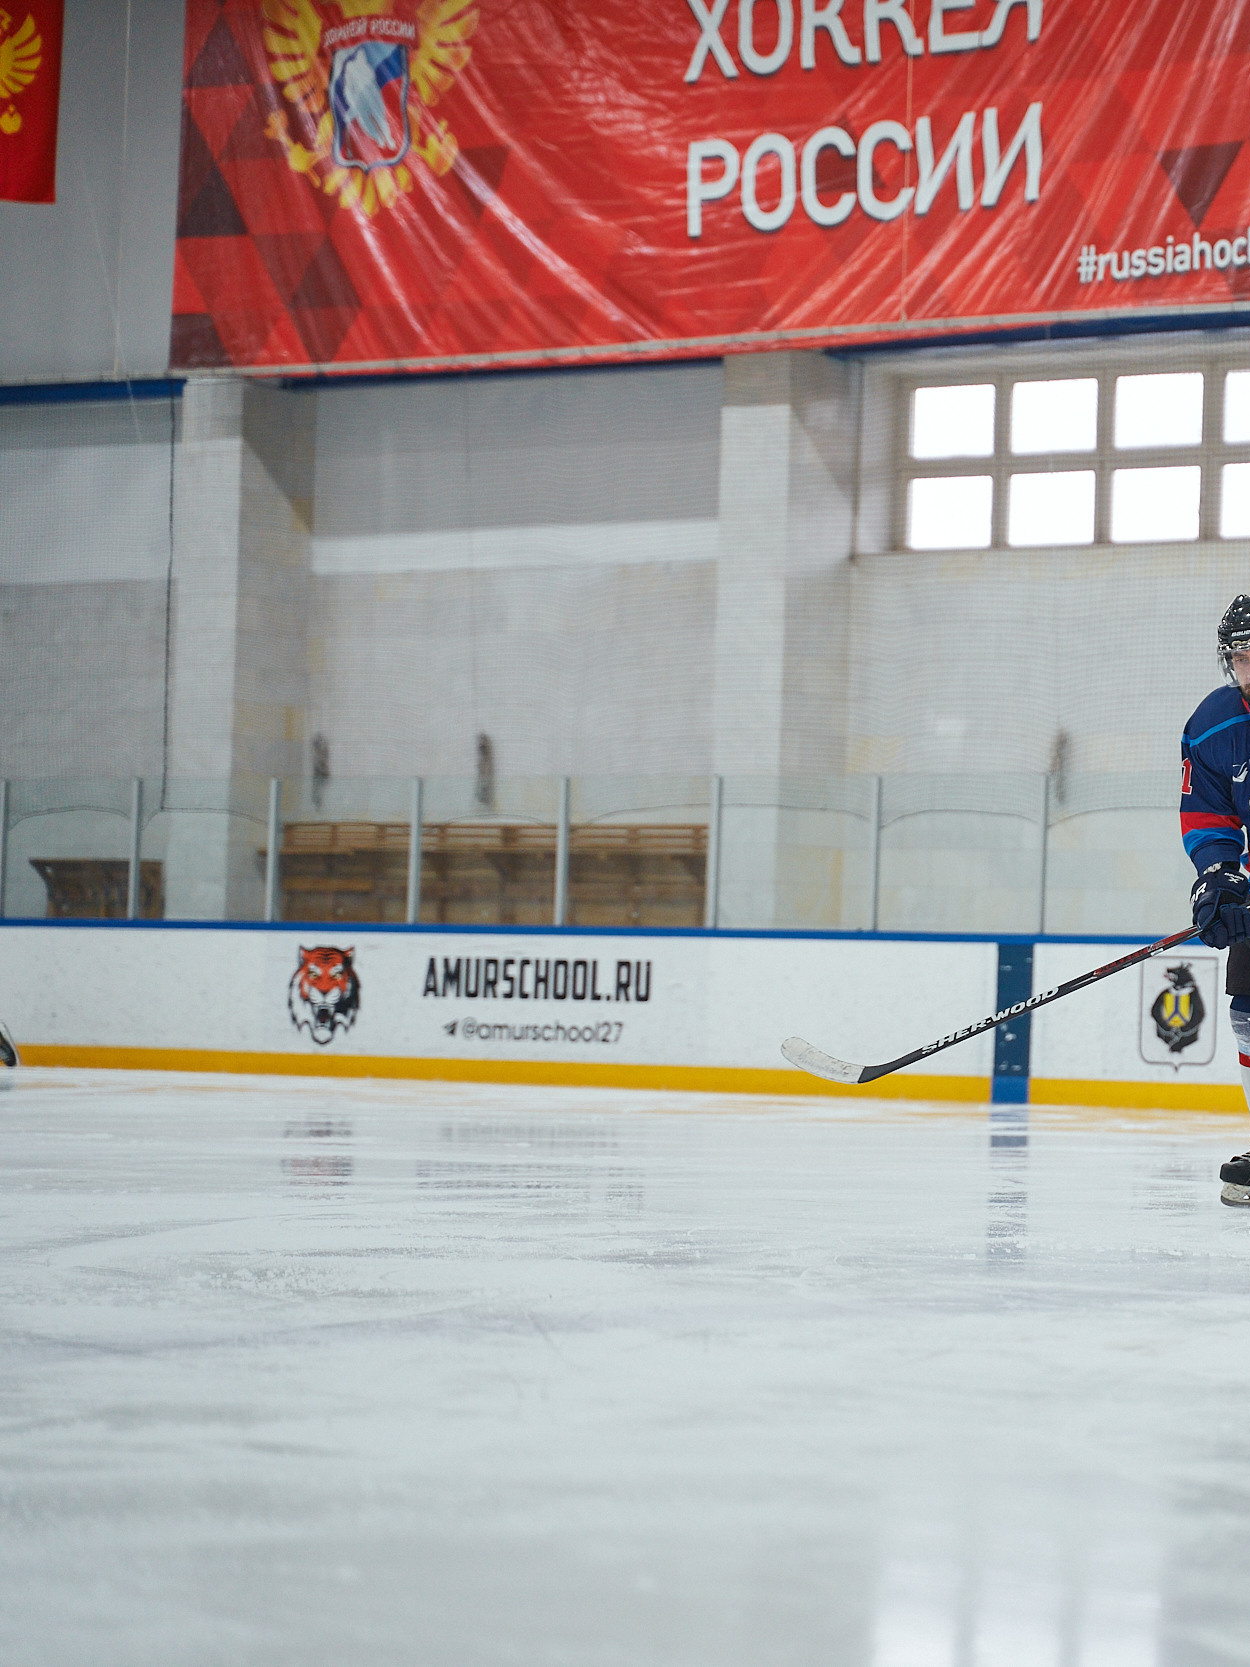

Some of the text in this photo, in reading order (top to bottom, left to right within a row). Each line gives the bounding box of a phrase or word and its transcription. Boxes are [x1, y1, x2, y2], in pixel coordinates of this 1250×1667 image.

[685, 101, 1044, 238] РОССИИ
[423, 956, 652, 1002] AMURSCHOOL.RU
[462, 1016, 625, 1044] @amurschool27
